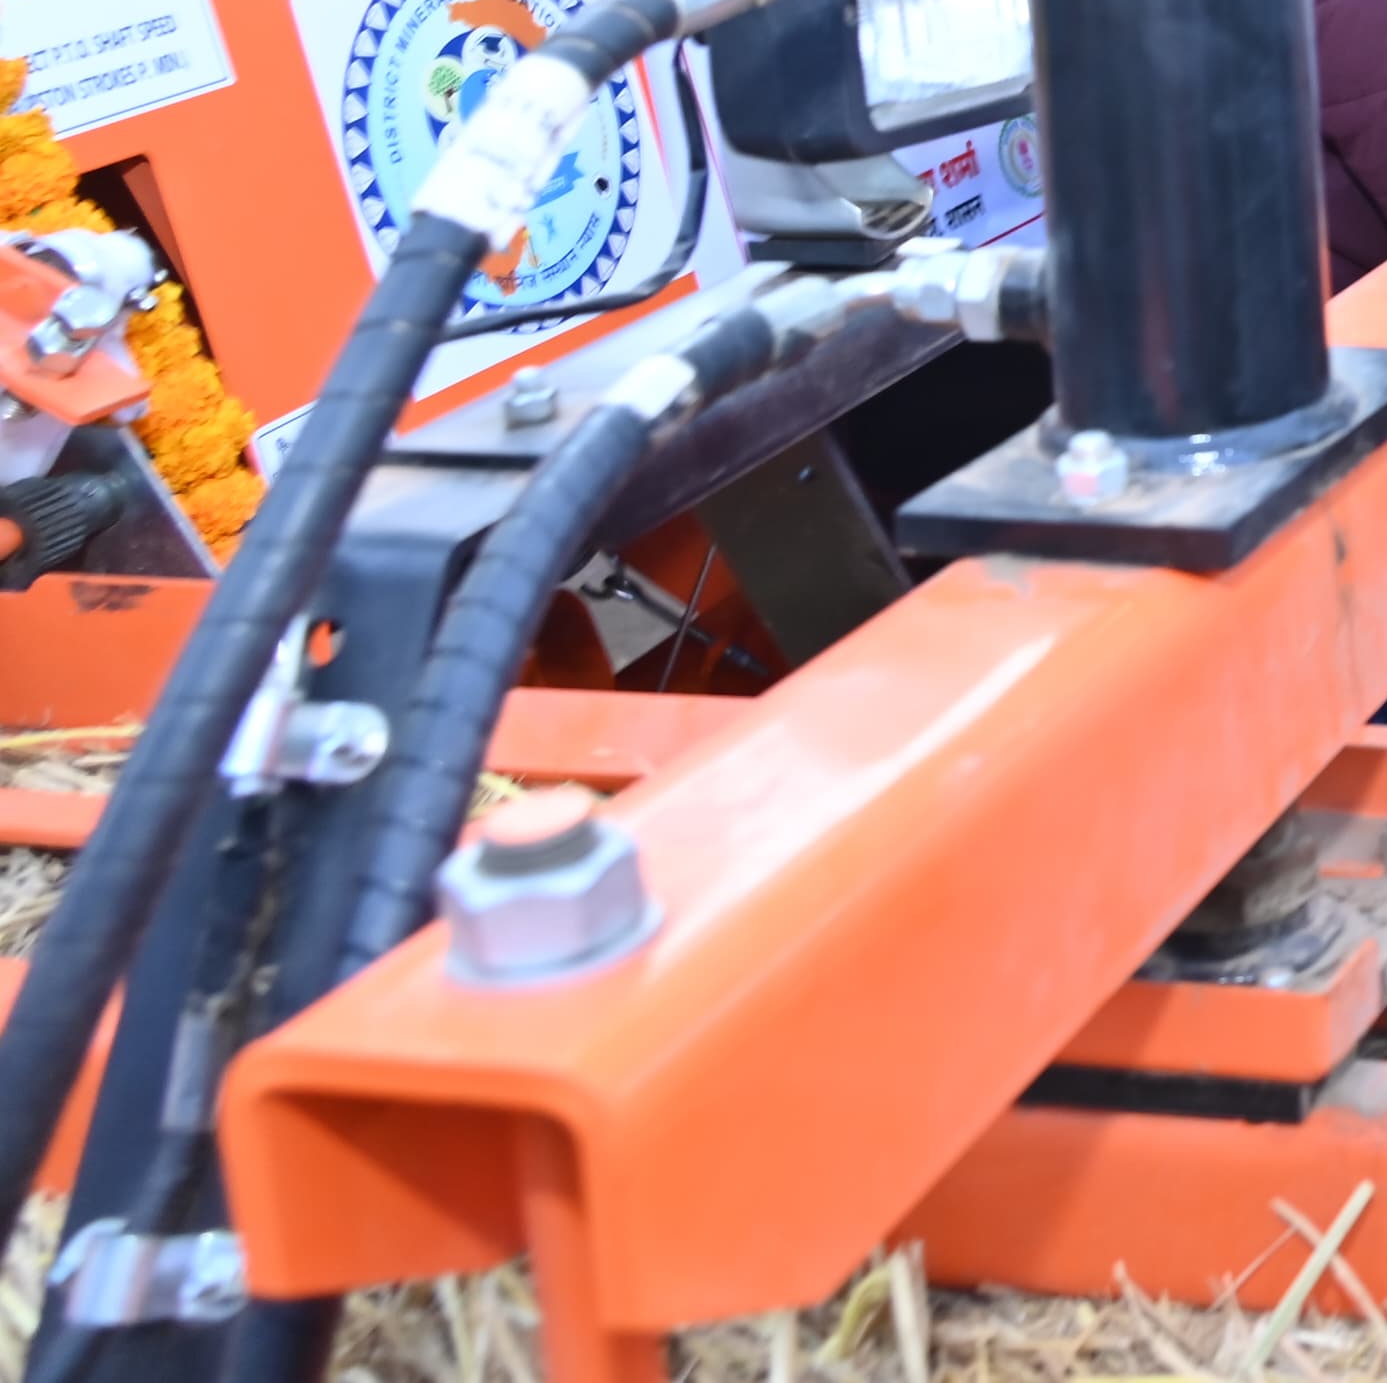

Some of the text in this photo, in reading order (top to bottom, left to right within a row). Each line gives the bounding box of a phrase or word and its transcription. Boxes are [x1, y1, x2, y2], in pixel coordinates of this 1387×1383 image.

[93, 24, 135, 56] SHAFT
[136, 15, 178, 42] SPEED
[78, 64, 138, 100] STROKES
[383, 55, 402, 165] DISTRICT
[939, 139, 981, 189] शर्मा
